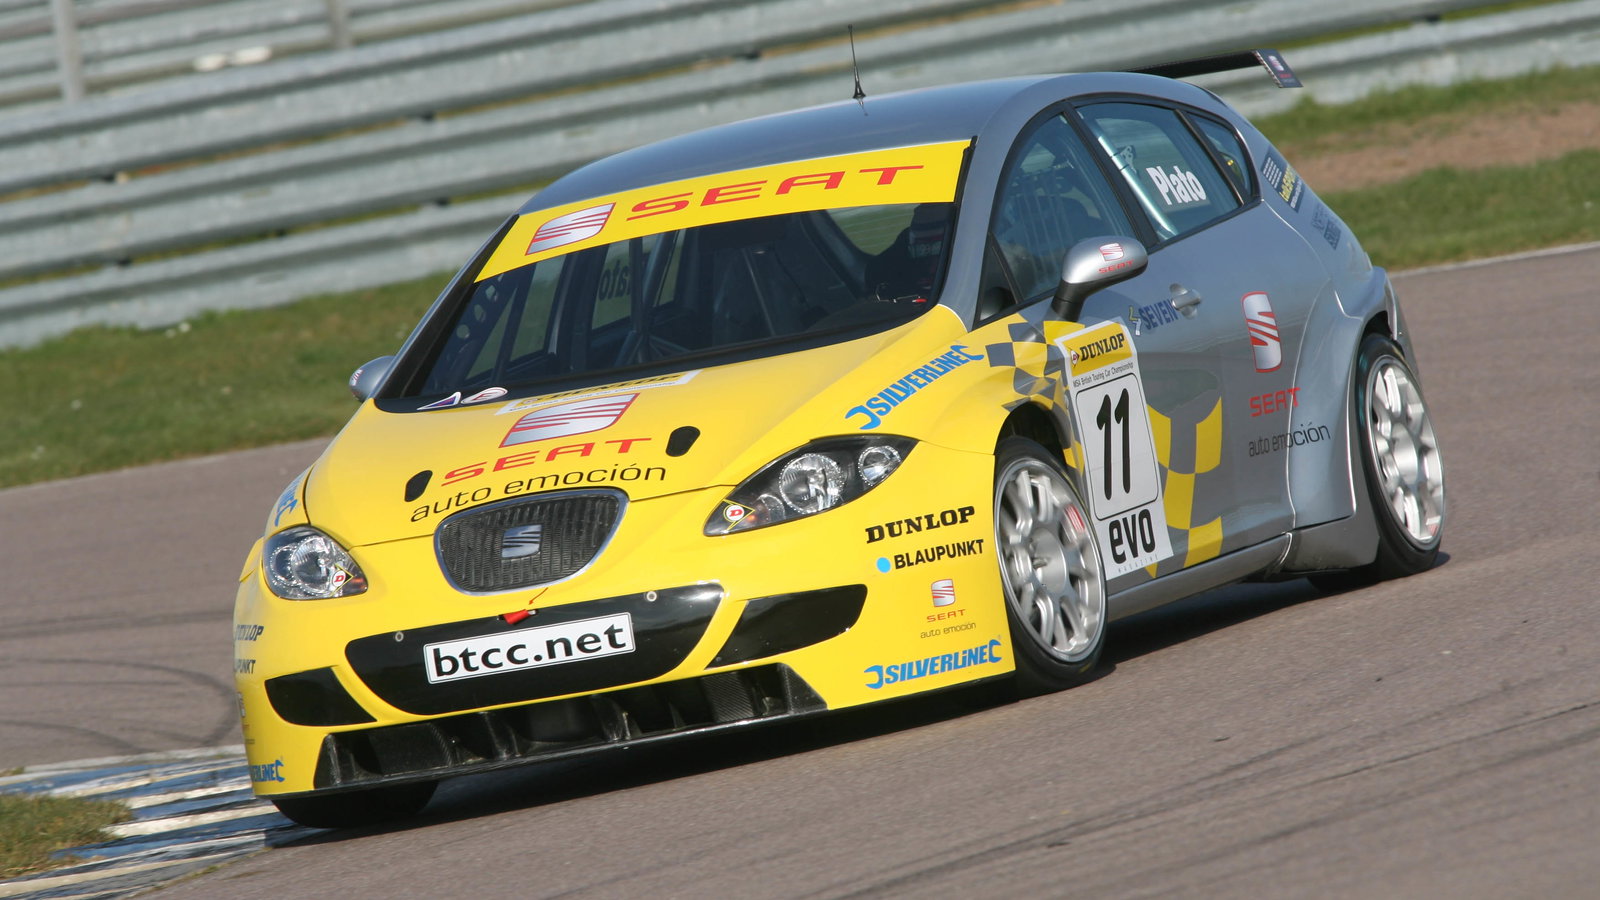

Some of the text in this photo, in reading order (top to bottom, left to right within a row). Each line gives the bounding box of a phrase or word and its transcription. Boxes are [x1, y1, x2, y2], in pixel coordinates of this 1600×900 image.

[627, 165, 924, 221] SEAT
[1146, 165, 1207, 206] Plato
[1098, 259, 1134, 274] SEAT
[1138, 299, 1179, 330] SEVEN
[1080, 333, 1125, 361] DUNLOP
[1092, 371, 1105, 381] Touring
[1111, 361, 1134, 375] Championship
[1249, 387, 1301, 417] SEAT
[1096, 387, 1131, 500] 11
[1249, 421, 1331, 457] auto emoción
[441, 438, 652, 486] SEAT
[410, 463, 666, 522] auto emoción
[865, 506, 975, 544] DUNLOP
[1108, 508, 1156, 564] evo
[894, 539, 984, 569] BLAUPUNKT
[920, 621, 976, 639] auto emoción
[926, 609, 966, 622] SEAT
[433, 624, 626, 677] btcc.net
